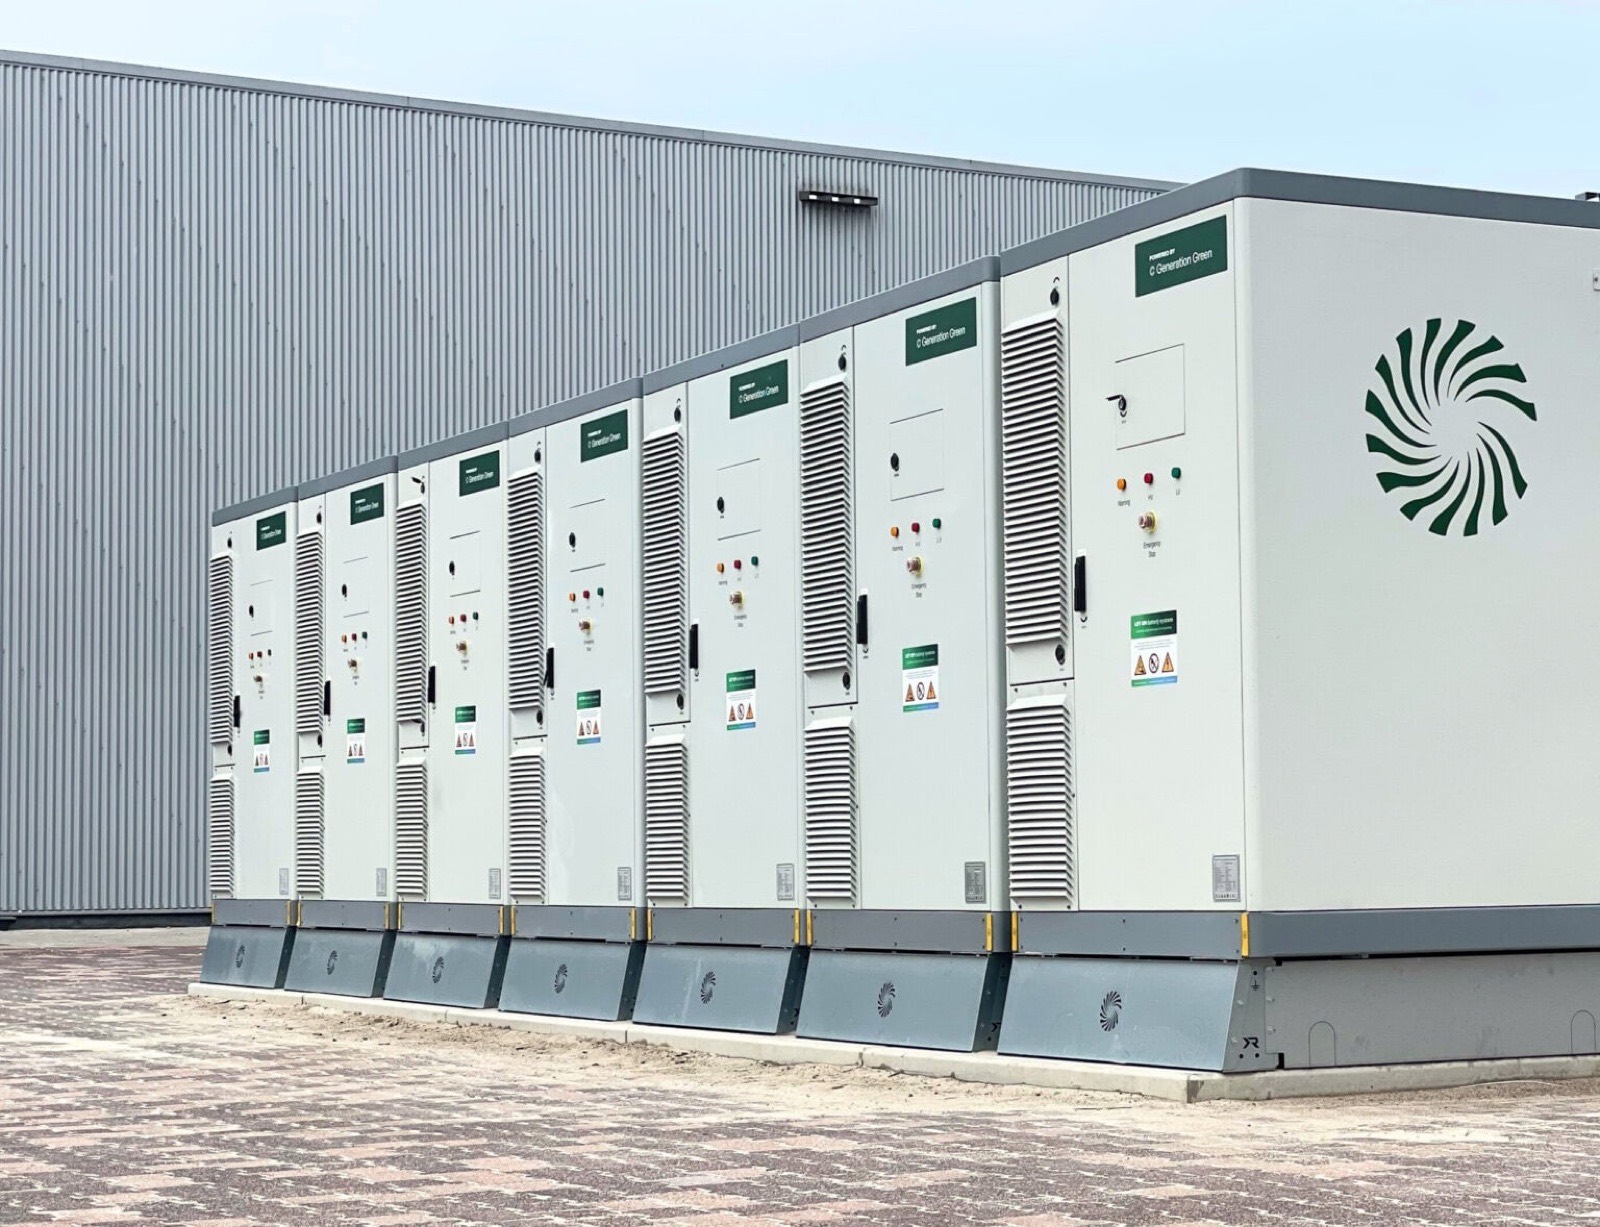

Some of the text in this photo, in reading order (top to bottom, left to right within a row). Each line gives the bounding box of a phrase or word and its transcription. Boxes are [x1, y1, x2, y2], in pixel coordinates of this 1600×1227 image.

[1156, 255, 1192, 274] Generation
[1192, 249, 1213, 263] Green
[922, 331, 949, 347] Generation
[949, 326, 966, 339] Green
